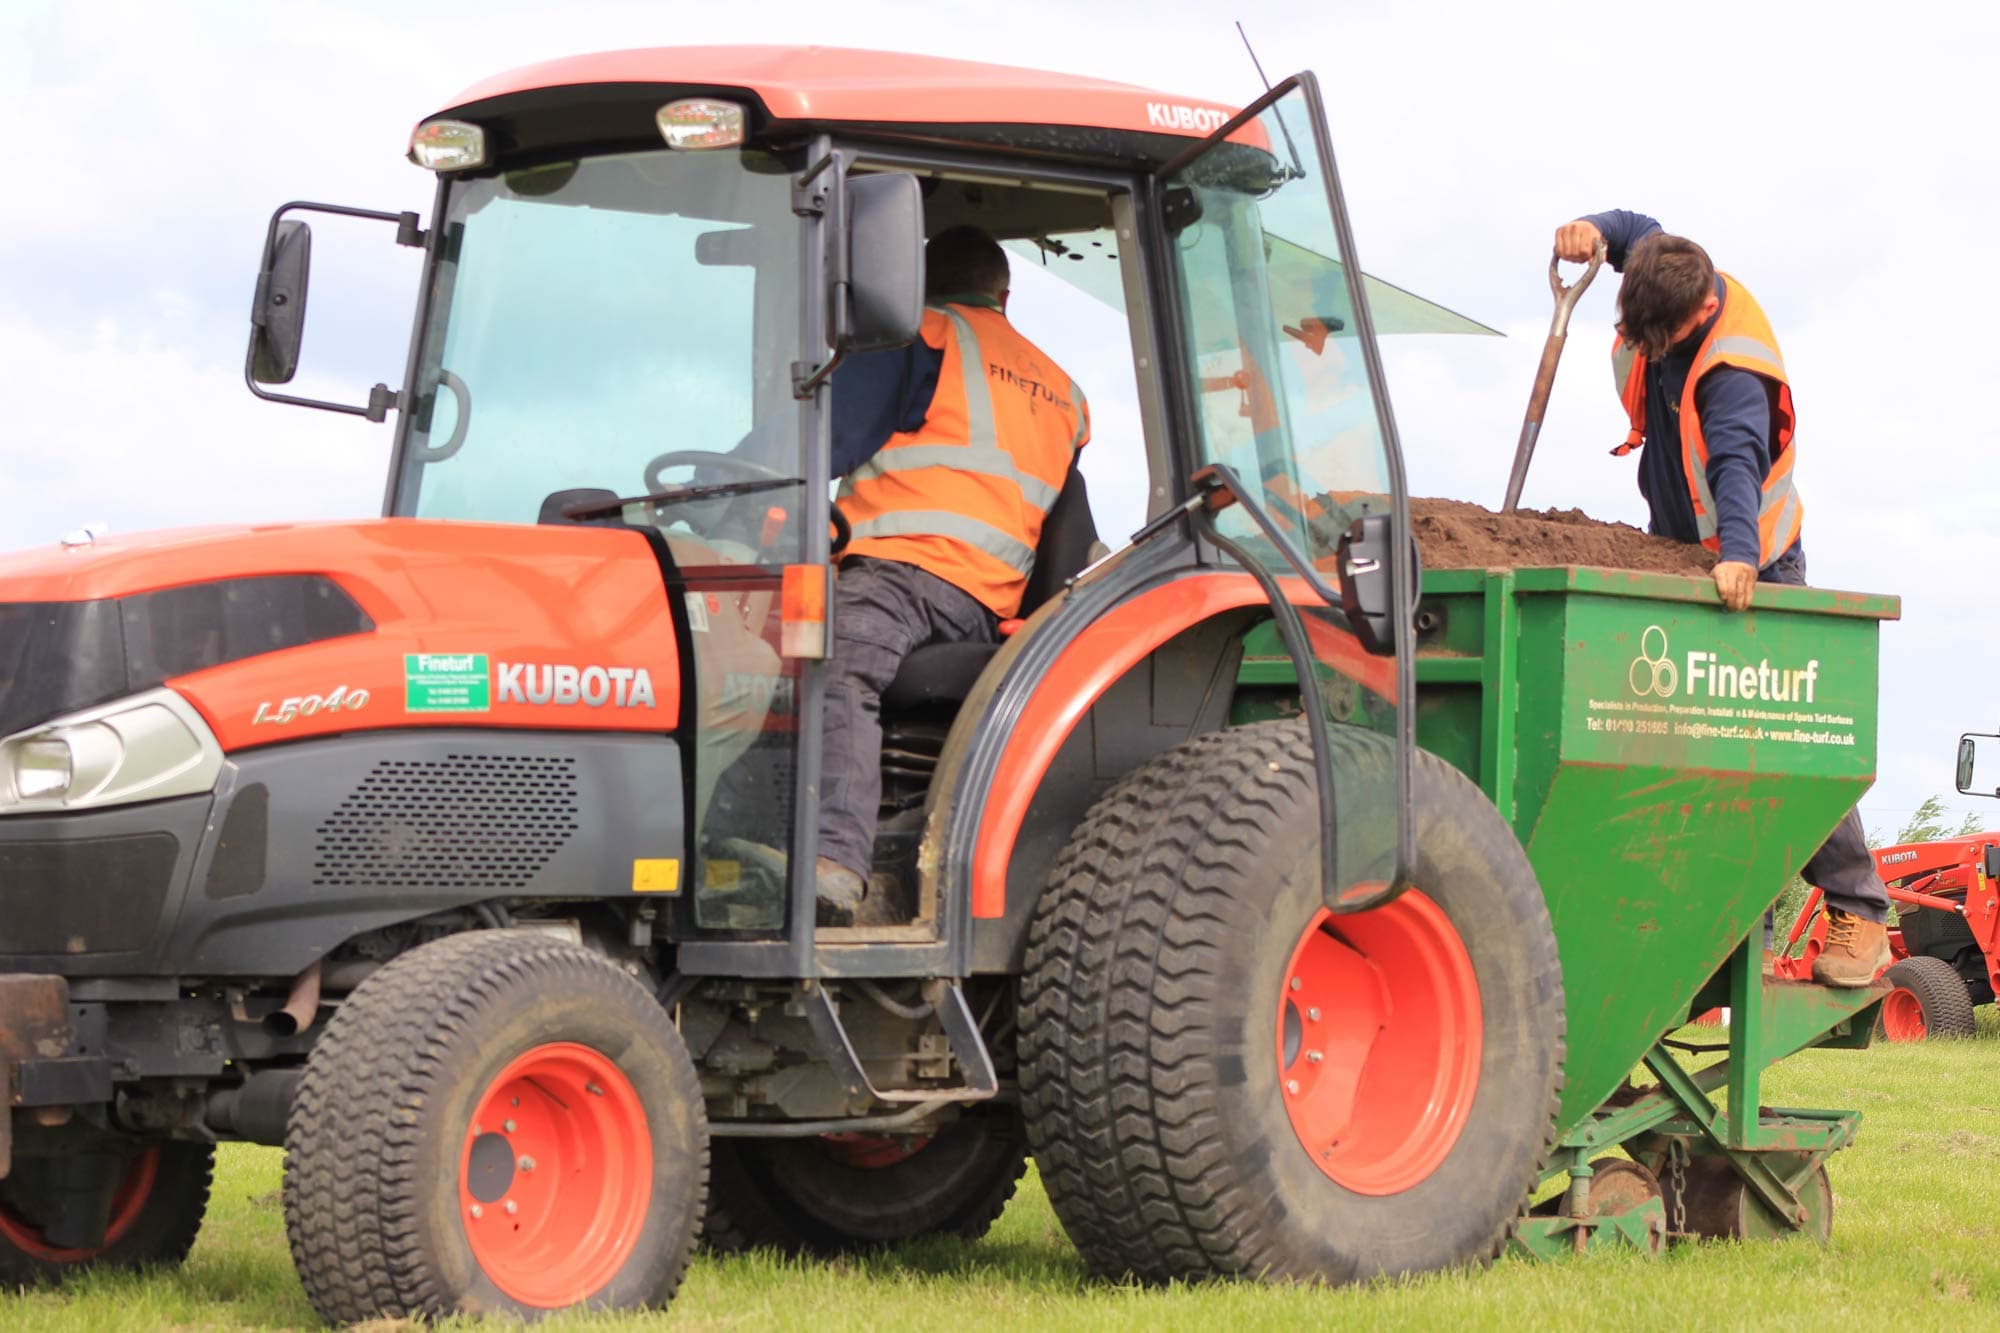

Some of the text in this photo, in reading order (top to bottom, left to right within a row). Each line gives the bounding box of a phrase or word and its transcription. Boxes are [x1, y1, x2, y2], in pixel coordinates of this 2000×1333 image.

[418, 654, 474, 673] Fineturf
[1686, 651, 1818, 703] Fineturf
[497, 662, 656, 709] KUBOTA
[251, 684, 370, 726] L5040
[1586, 717, 1604, 731] Tel:
[1770, 729, 1855, 746] www.fine-turf.co.uk
[1881, 850, 1918, 865] KUBOTA
